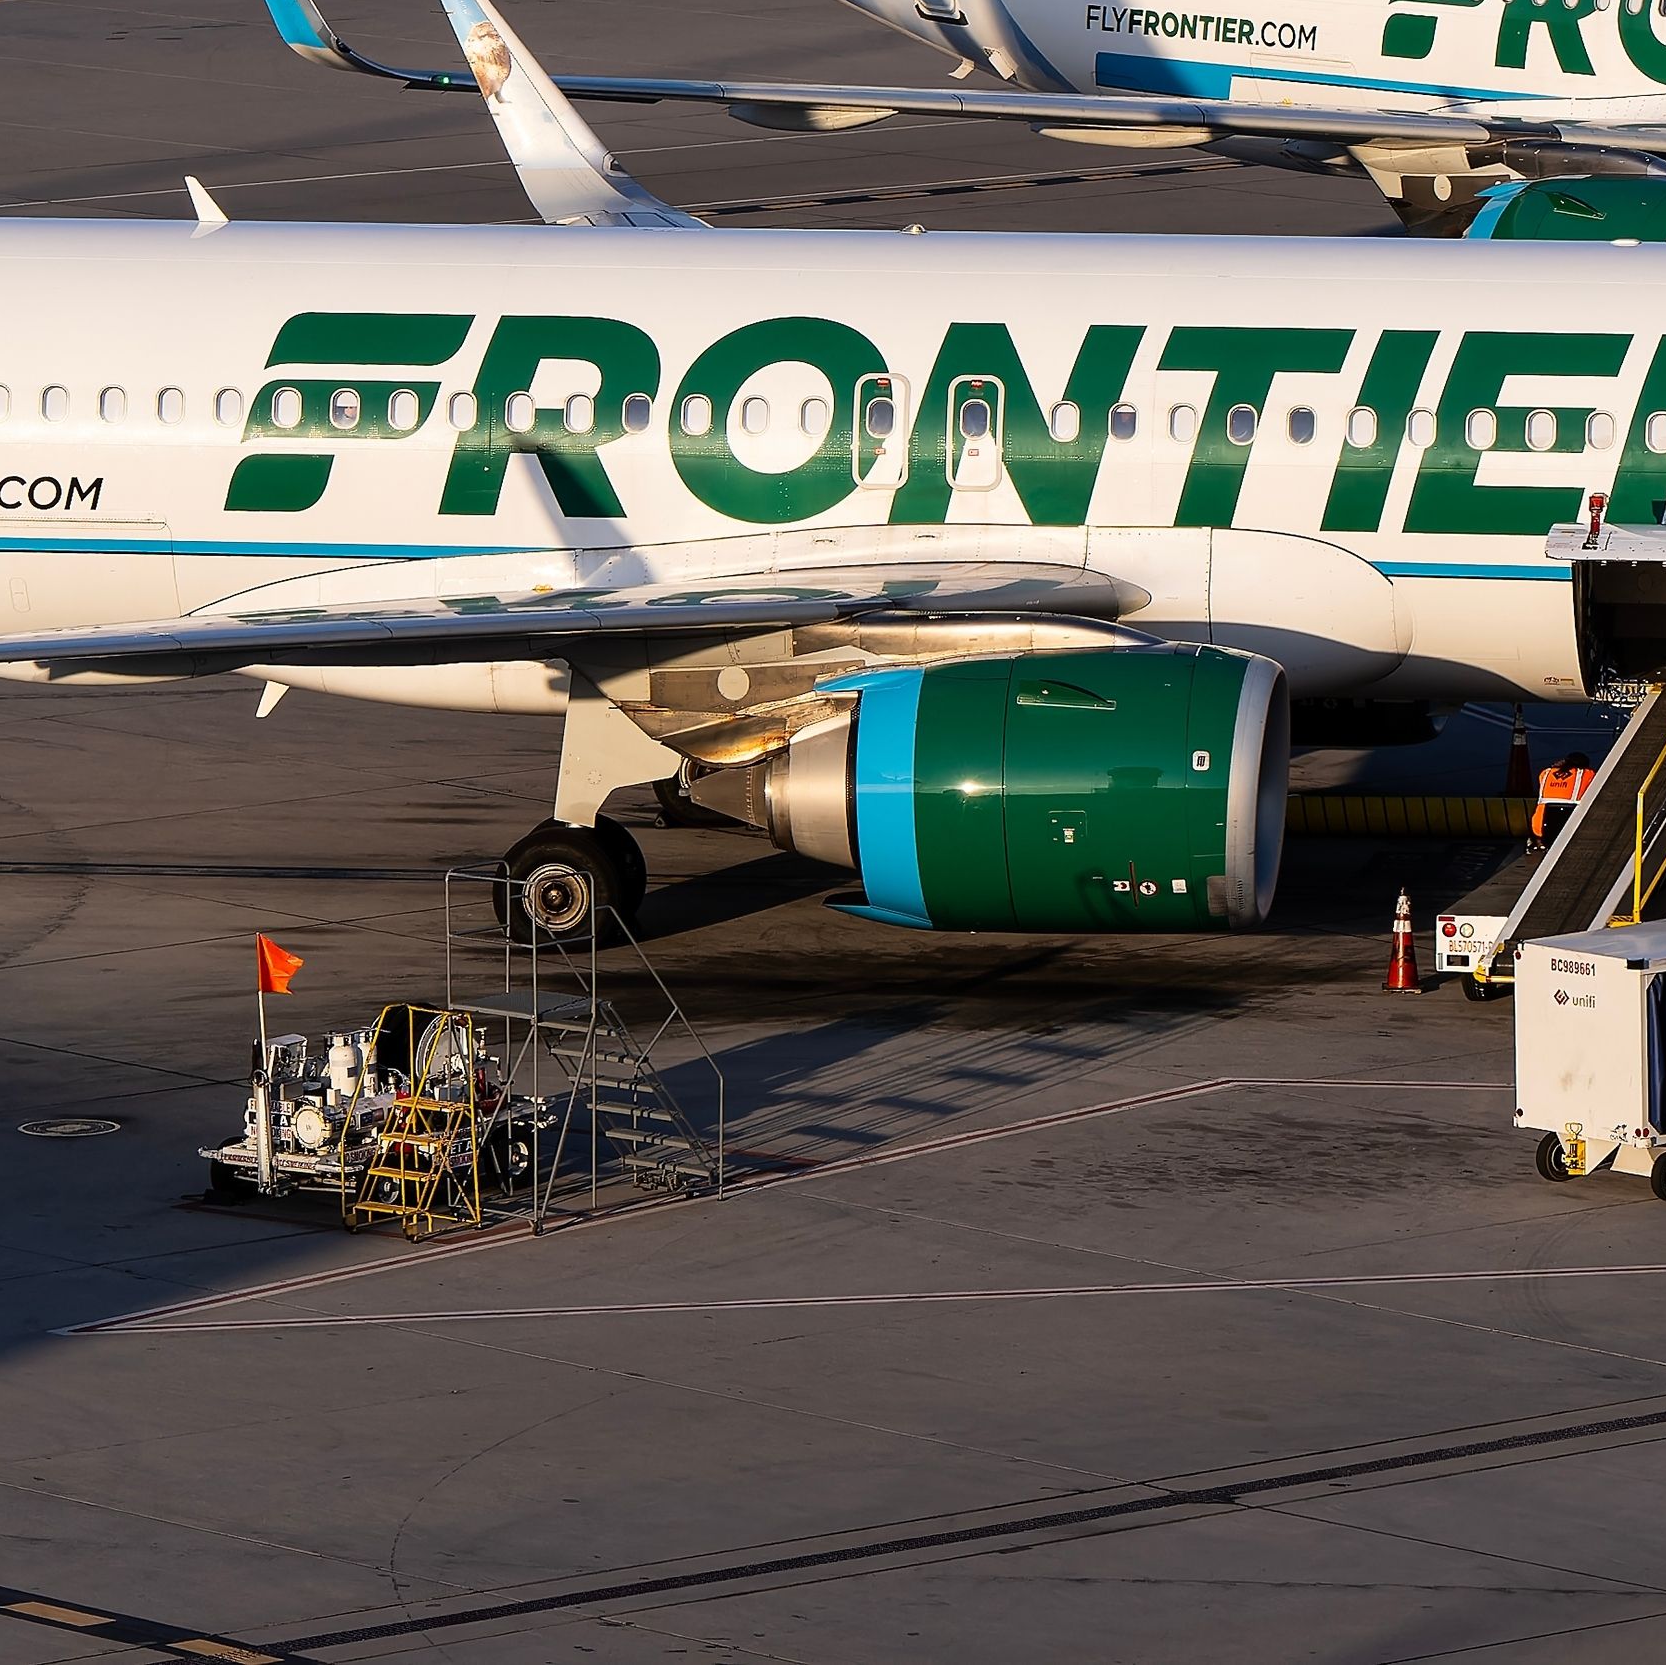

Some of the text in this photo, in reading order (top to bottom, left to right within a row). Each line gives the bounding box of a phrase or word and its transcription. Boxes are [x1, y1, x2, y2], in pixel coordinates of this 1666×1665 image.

[1085, 4, 1318, 52] FLYFRONTIER.COM
[1549, 781, 1568, 789] unifi
[1551, 958, 1595, 977] BC989661
[1572, 994, 1595, 1009] unifi
